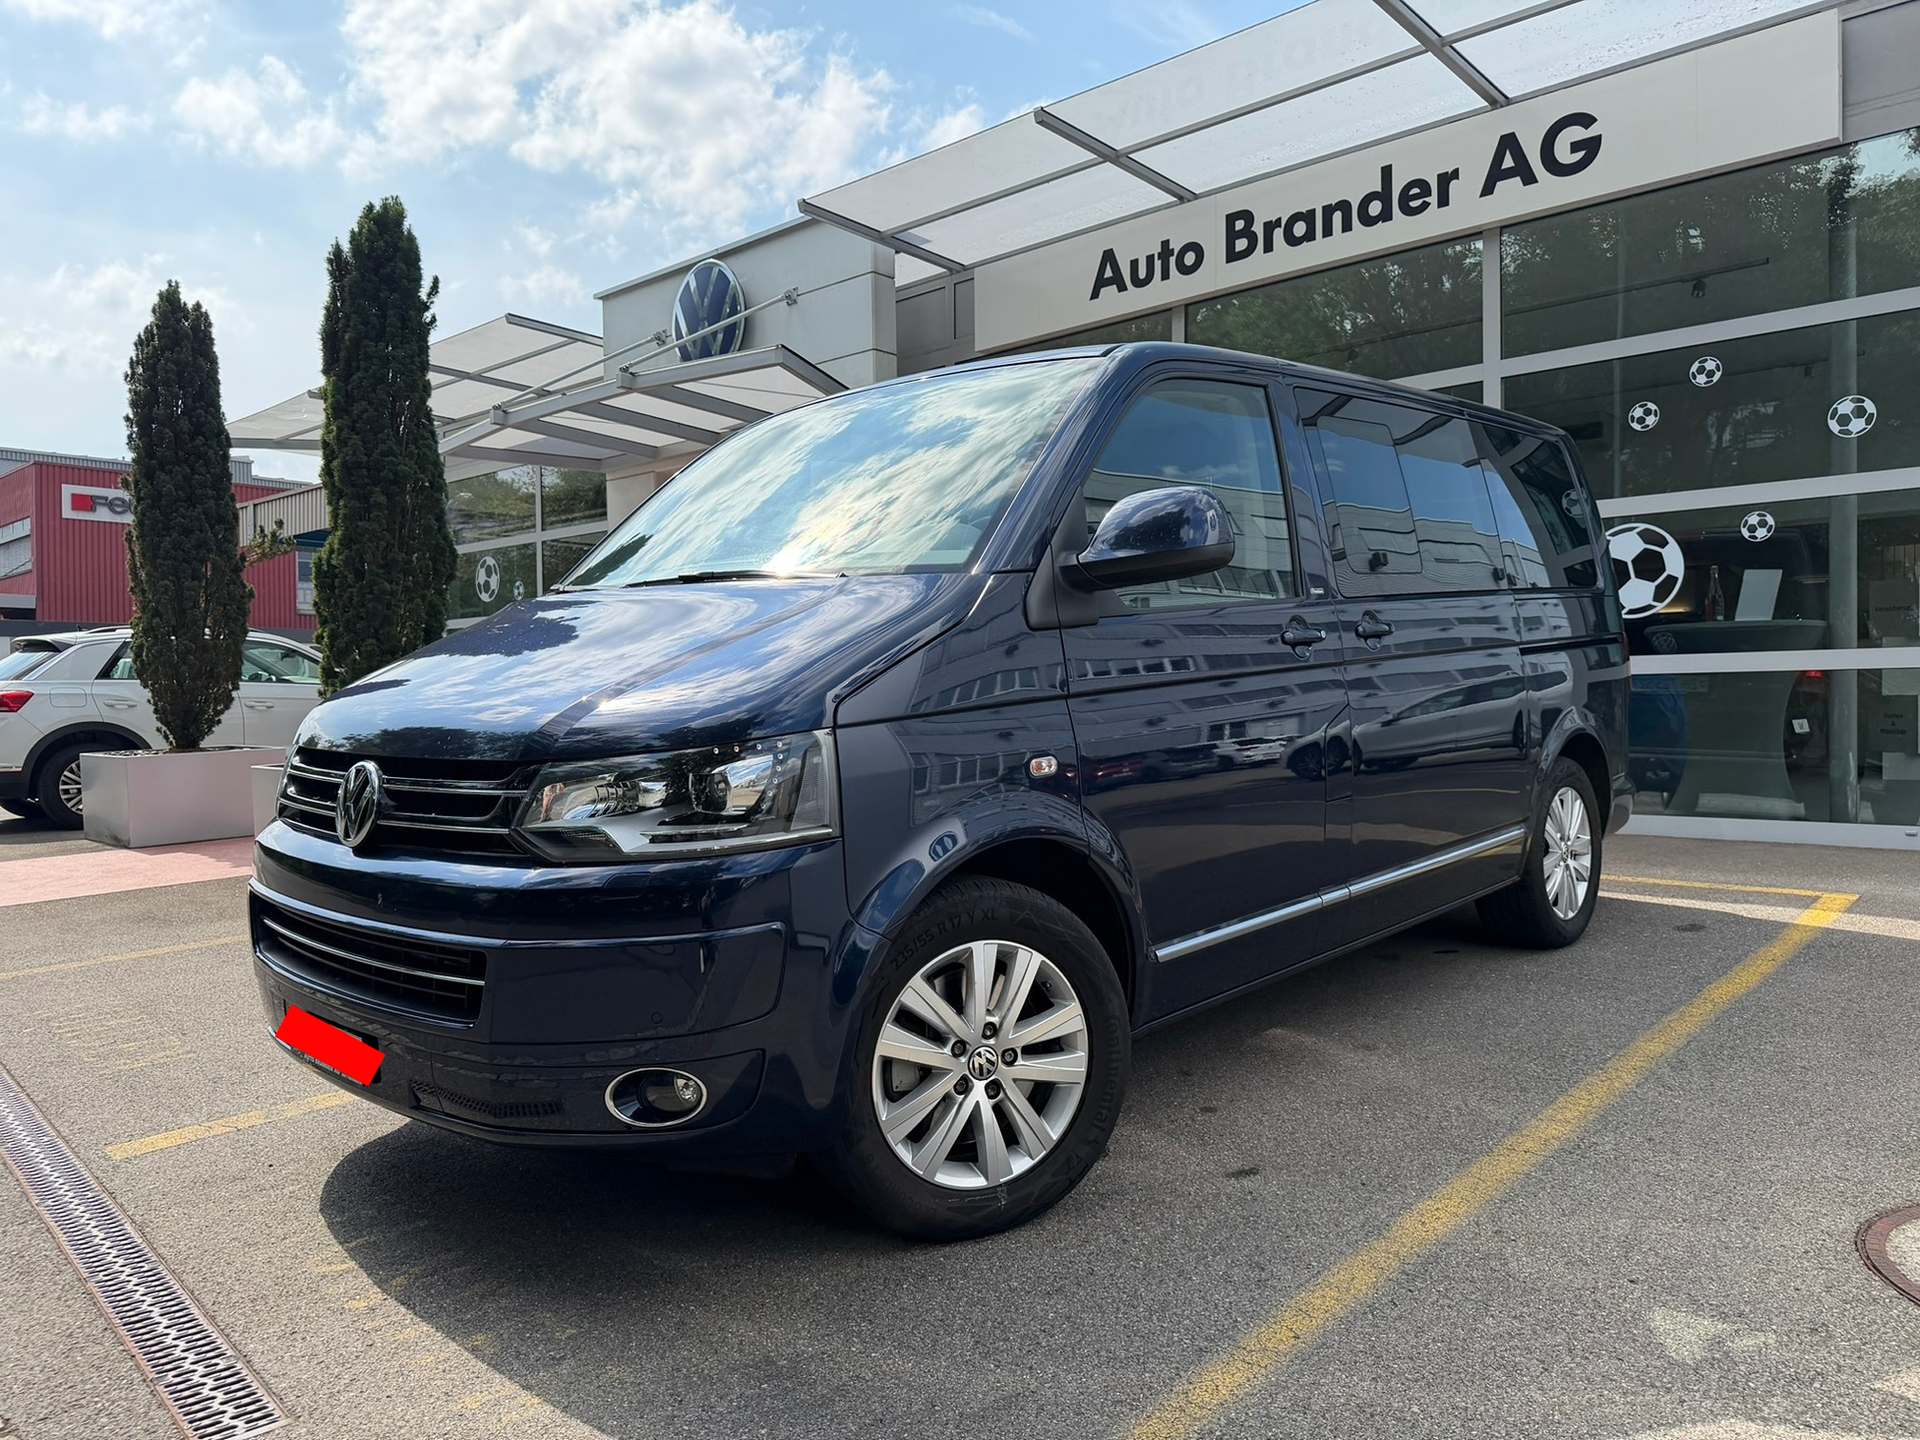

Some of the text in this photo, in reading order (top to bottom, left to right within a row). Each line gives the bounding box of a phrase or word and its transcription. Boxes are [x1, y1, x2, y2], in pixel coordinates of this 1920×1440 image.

[1089, 111, 1603, 300] Auto Brander AG
[891, 928, 935, 971] 235/55
[950, 915, 962, 930] 17
[980, 908, 998, 921] XL
